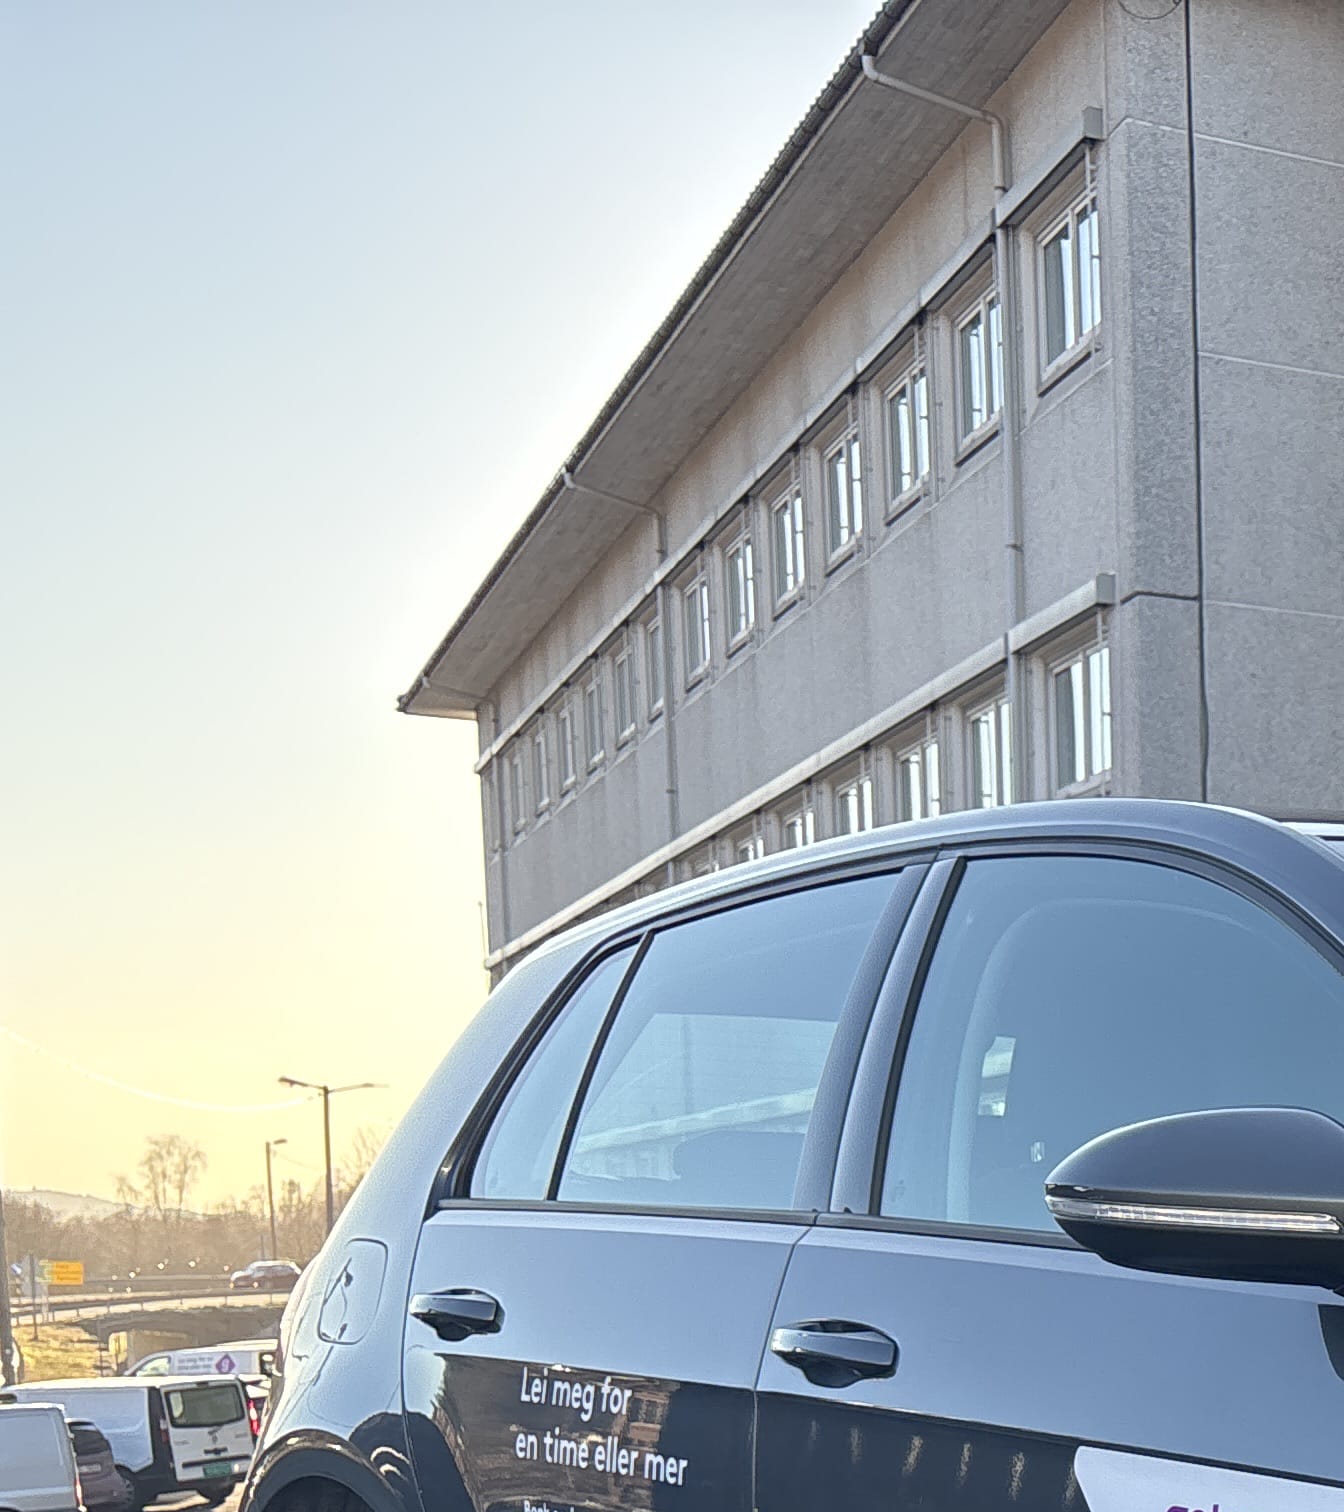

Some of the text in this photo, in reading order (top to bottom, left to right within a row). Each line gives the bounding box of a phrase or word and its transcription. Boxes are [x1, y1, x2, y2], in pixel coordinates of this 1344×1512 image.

[521, 1366, 632, 1422] Lei meg for
[515, 1427, 688, 1486] en time eller mer
